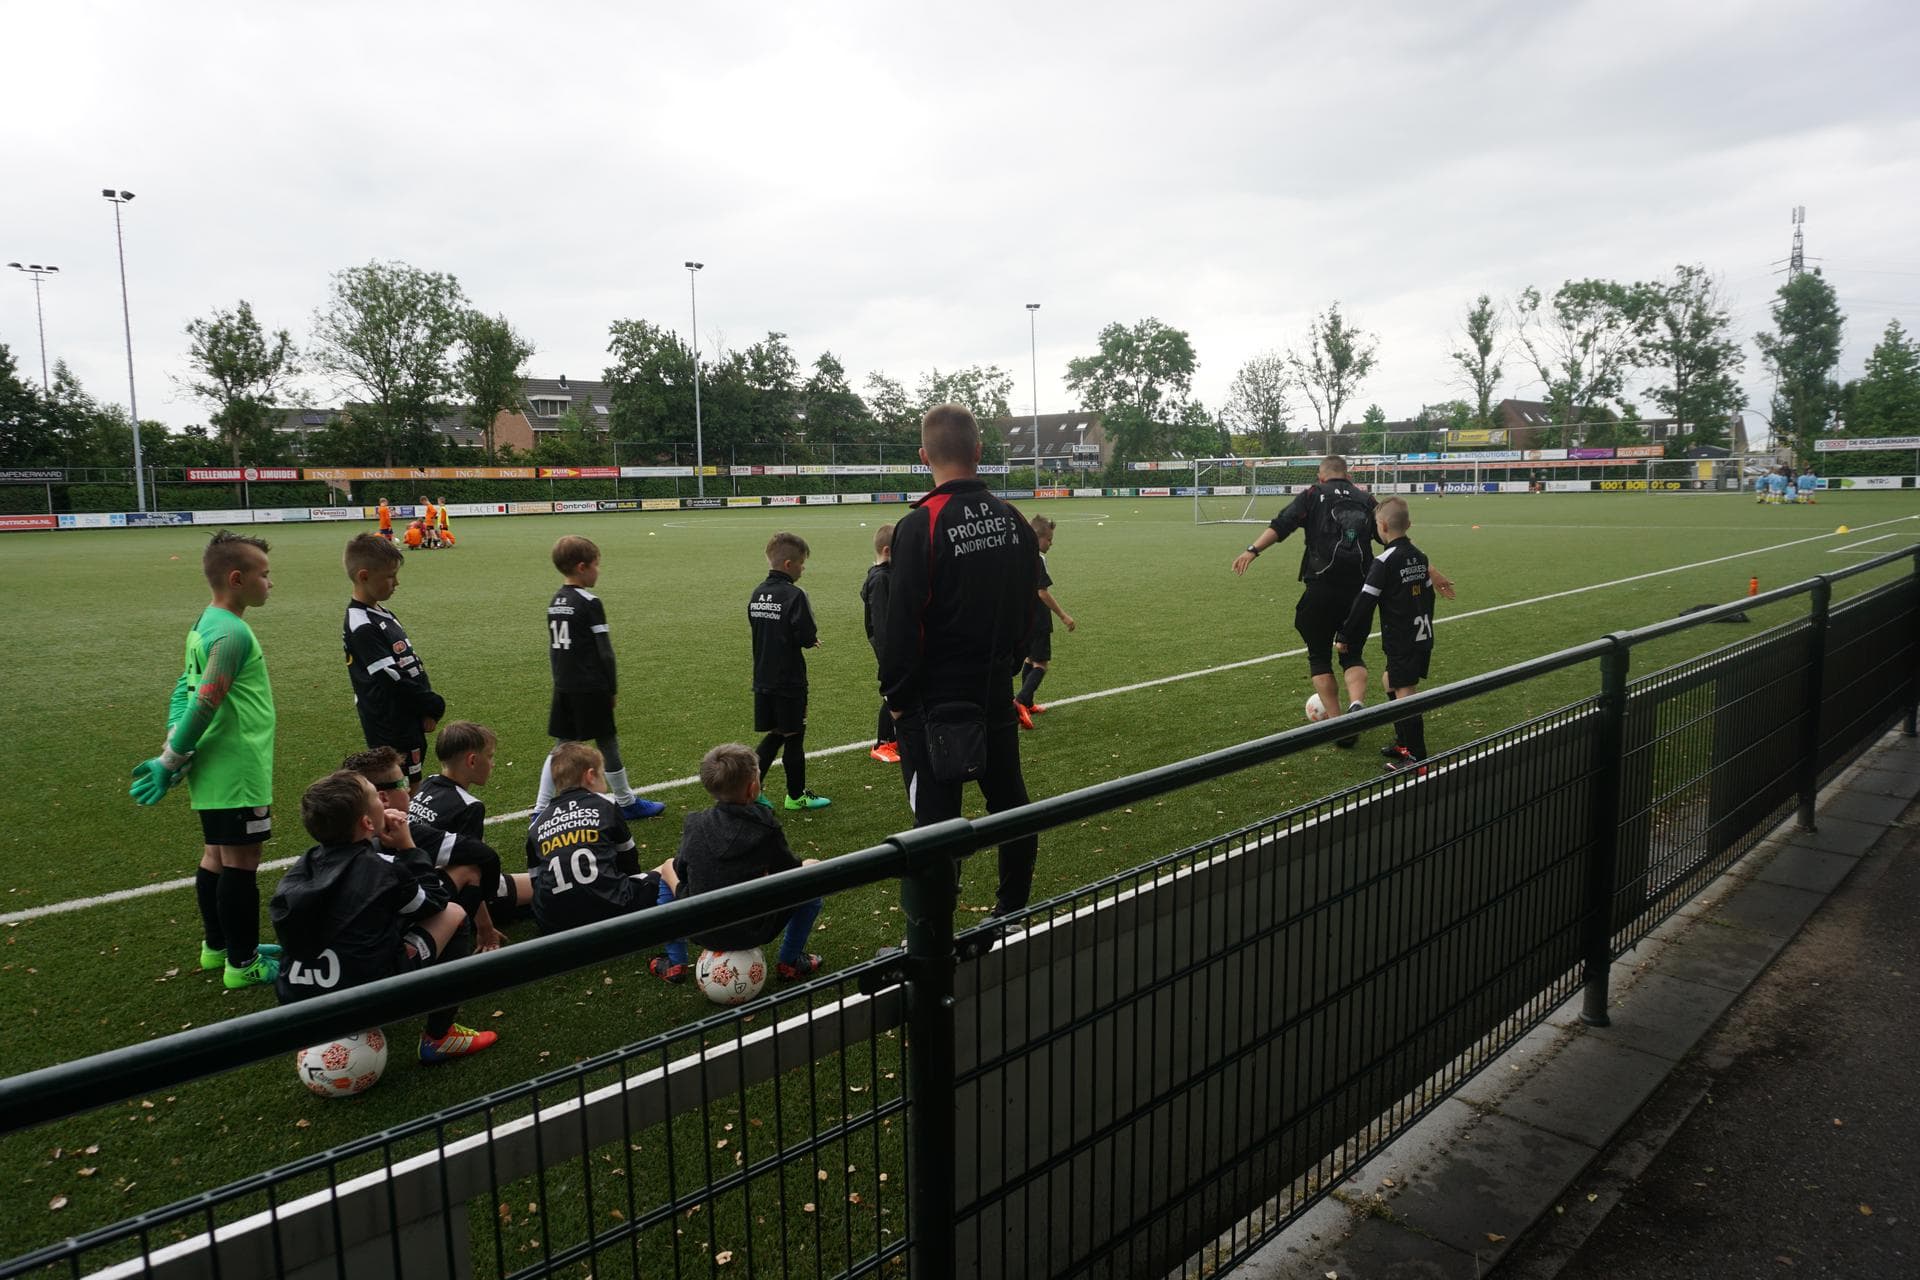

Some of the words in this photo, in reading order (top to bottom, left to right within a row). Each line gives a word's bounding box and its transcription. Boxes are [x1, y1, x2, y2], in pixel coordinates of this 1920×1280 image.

[190, 470, 241, 480] STELLENDAM
[312, 471, 332, 479] ING
[362, 471, 382, 479] ING
[410, 470, 429, 479] ING
[455, 470, 473, 478] ING
[500, 470, 517, 478] ING
[976, 466, 1003, 474] ANSPORT
[1039, 489, 1055, 498] ING
[1599, 481, 1623, 490] 100%
[1626, 481, 1648, 490] BOB
[1666, 482, 1681, 491] op
[964, 505, 978, 520] A.
[979, 502, 993, 517] P.
[750, 602, 782, 612] PROGRESS
[550, 620, 572, 650] 14
[1413, 613, 1433, 642] 21
[409, 800, 438, 822] GRESS
[552, 806, 566, 817] A.
[568, 800, 579, 811] P.
[537, 808, 600, 834] PROGRESS
[541, 829, 600, 856] DAWID
[549, 847, 599, 895] 10
